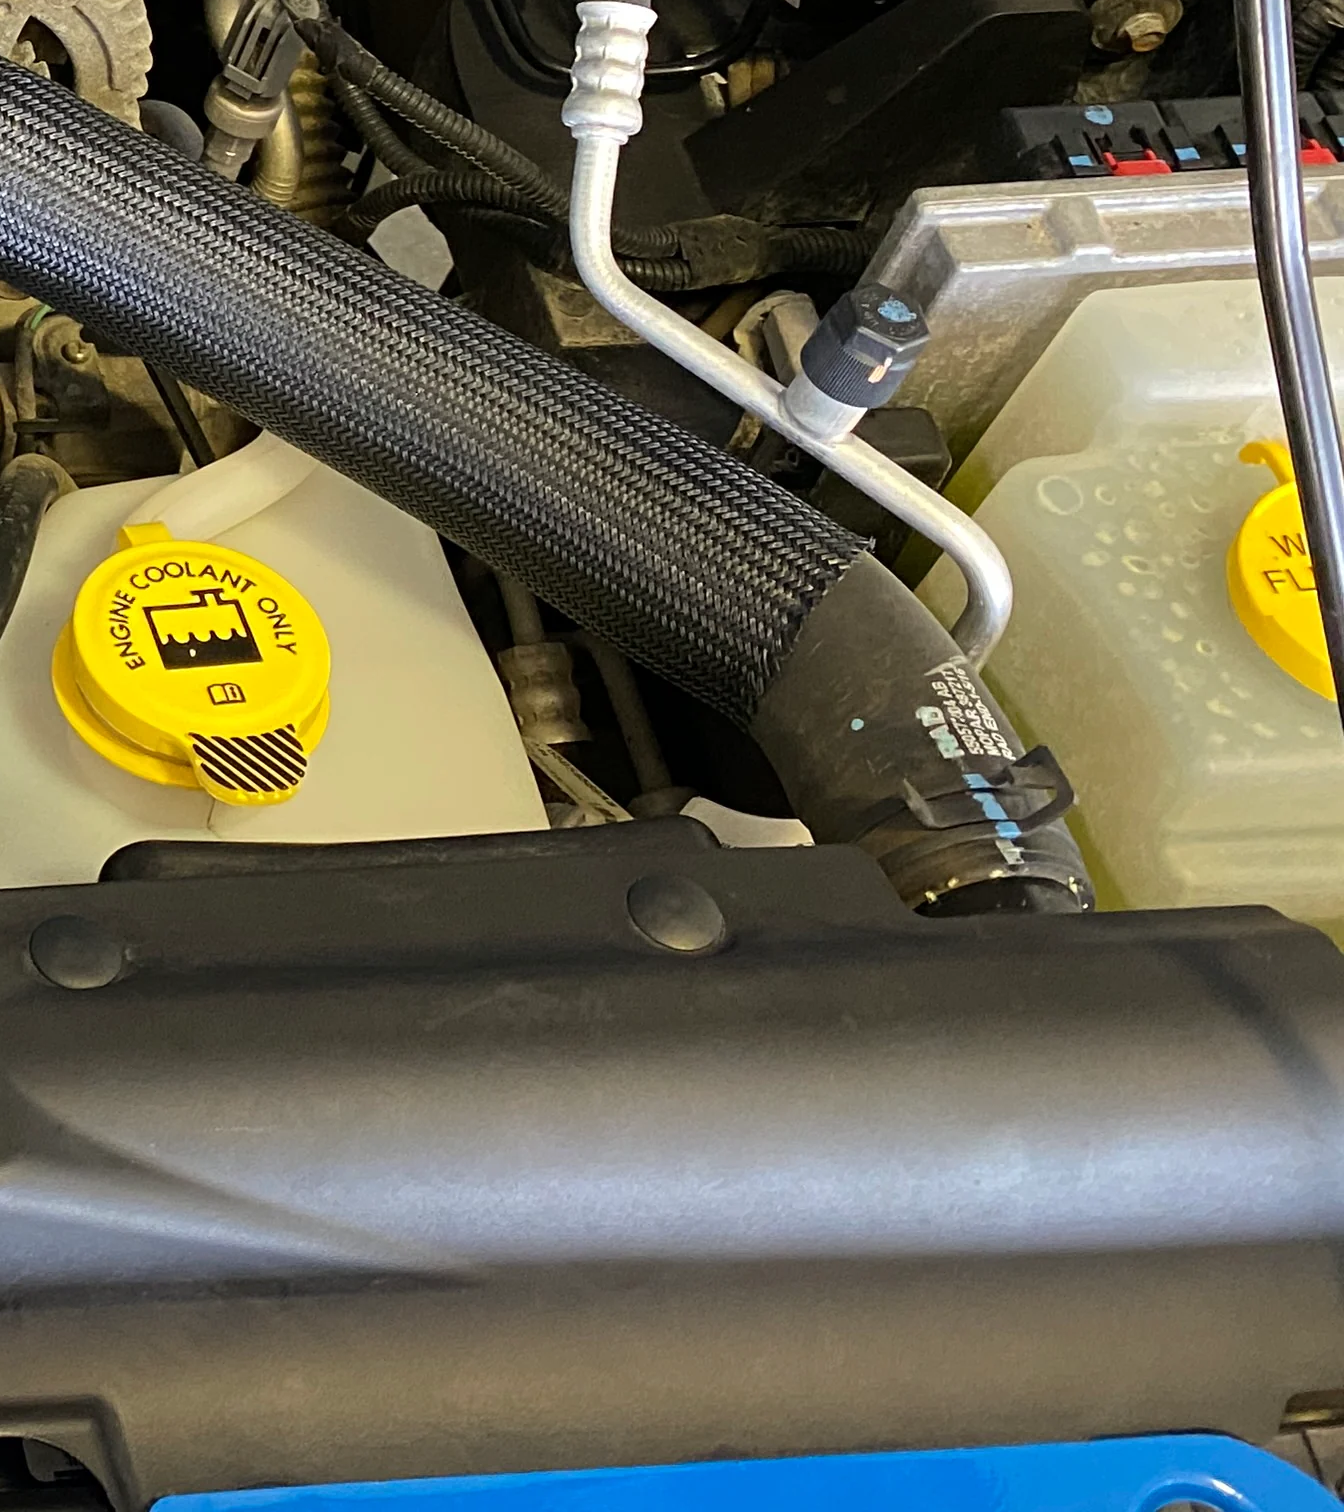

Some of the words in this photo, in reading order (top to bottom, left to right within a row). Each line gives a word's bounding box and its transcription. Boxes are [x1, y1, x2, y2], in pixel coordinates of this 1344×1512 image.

[109, 590, 146, 670] ENGINE
[129, 561, 257, 594] COOLANT
[257, 597, 297, 655] ONLY
